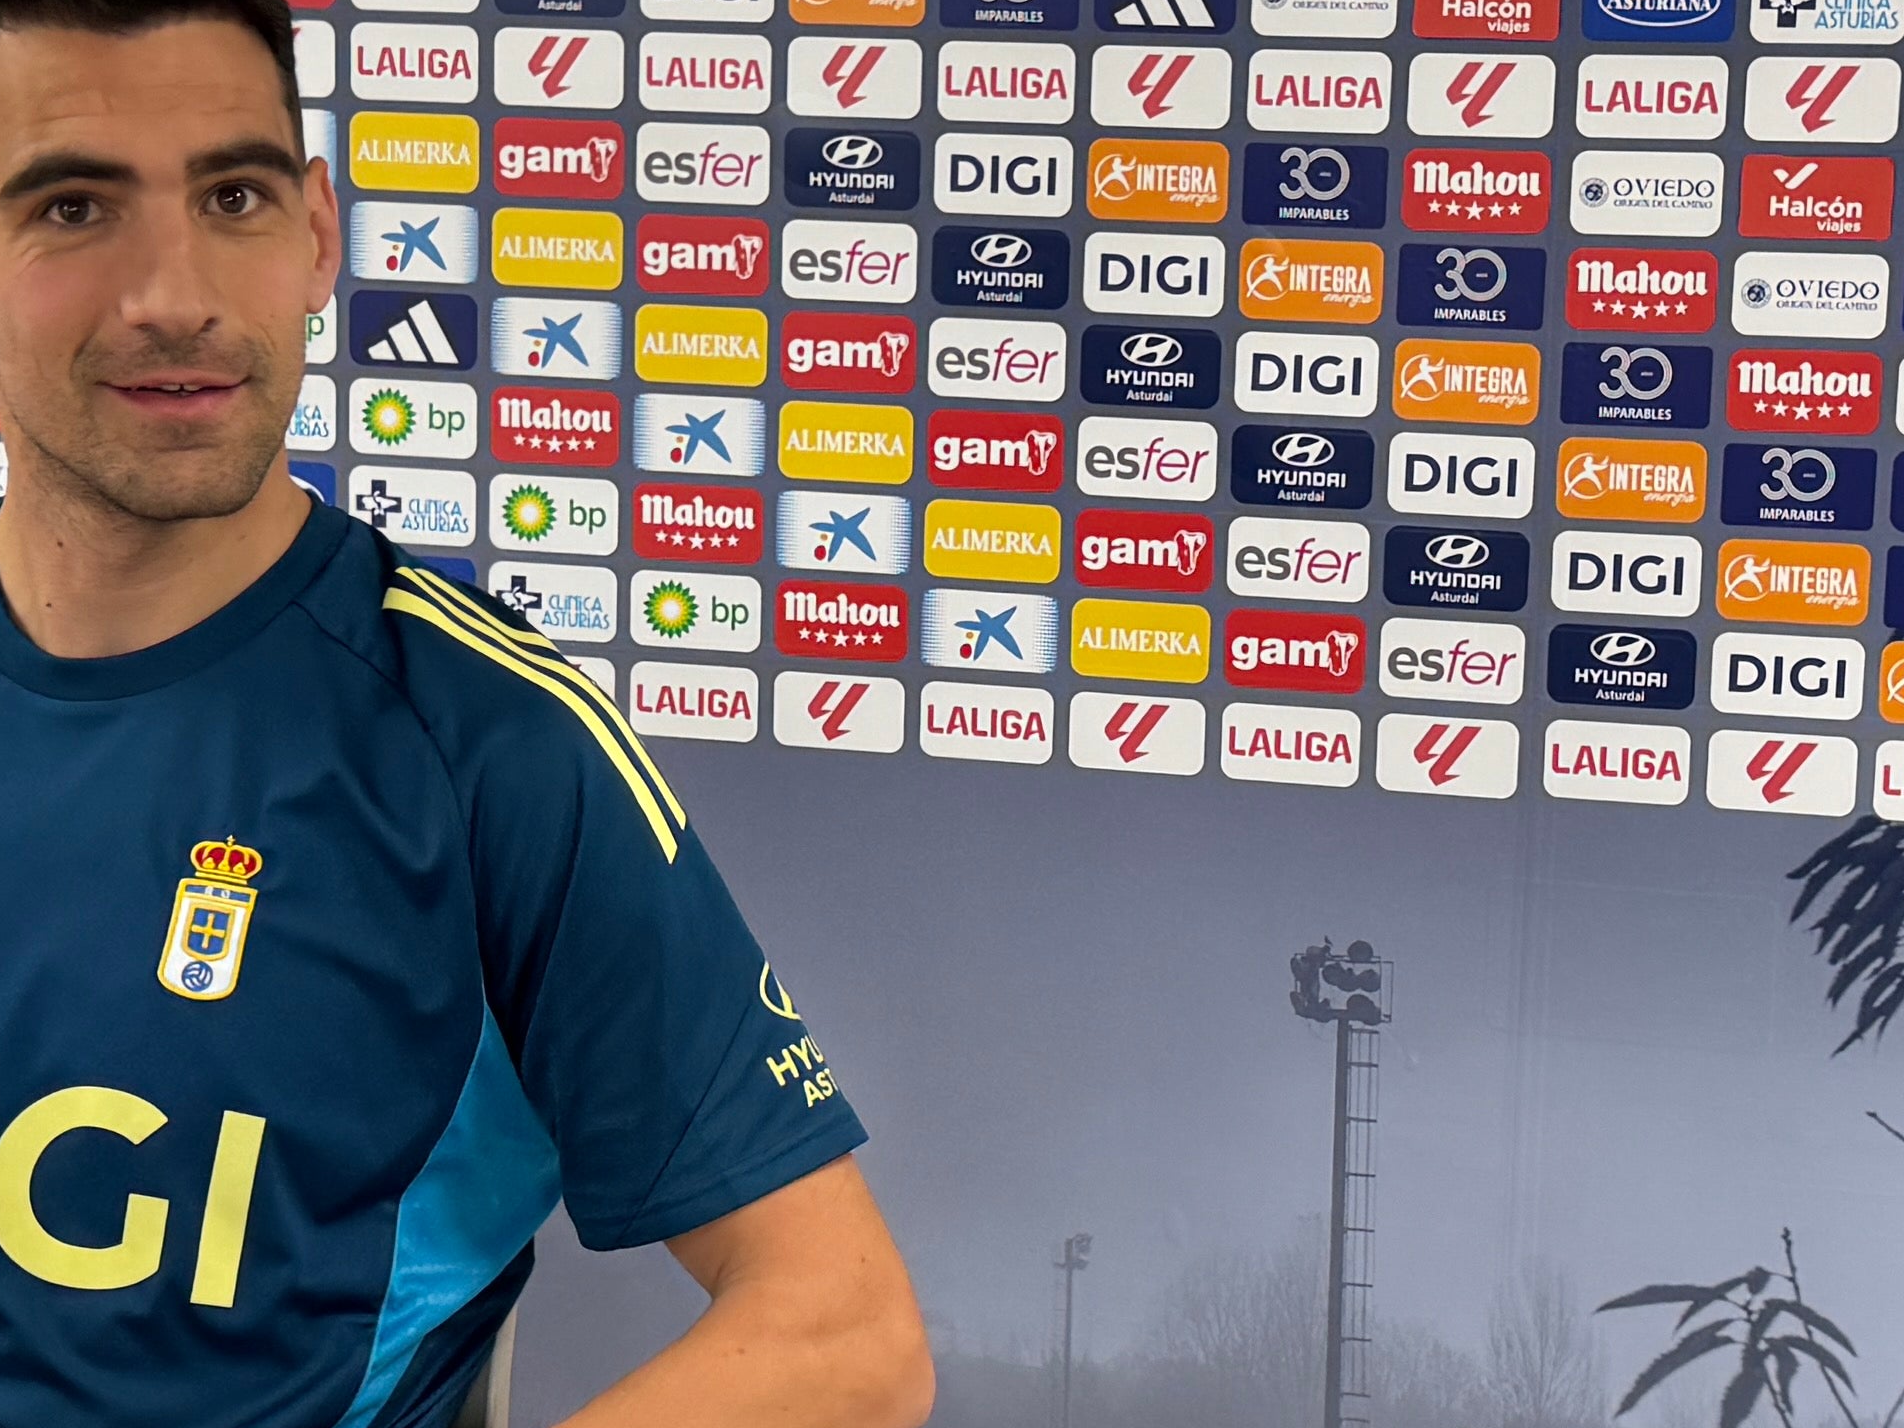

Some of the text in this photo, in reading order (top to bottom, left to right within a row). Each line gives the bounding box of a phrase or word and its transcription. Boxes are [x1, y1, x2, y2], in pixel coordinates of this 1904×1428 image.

[356, 47, 472, 79] LALIGA
[1584, 81, 1719, 114] LALIGA
[644, 142, 762, 187] esfer
[809, 172, 894, 190] HYUNDAI
[1770, 196, 1862, 218] Halcón
[1817, 218, 1861, 234] viajes
[1100, 254, 1208, 295] DIGI
[1738, 361, 1872, 397] Mahou
[788, 431, 904, 455] ALIMERKA
[1235, 538, 1361, 584] esfer
[712, 596, 748, 630] bp
[1729, 654, 1846, 698] DIGI
